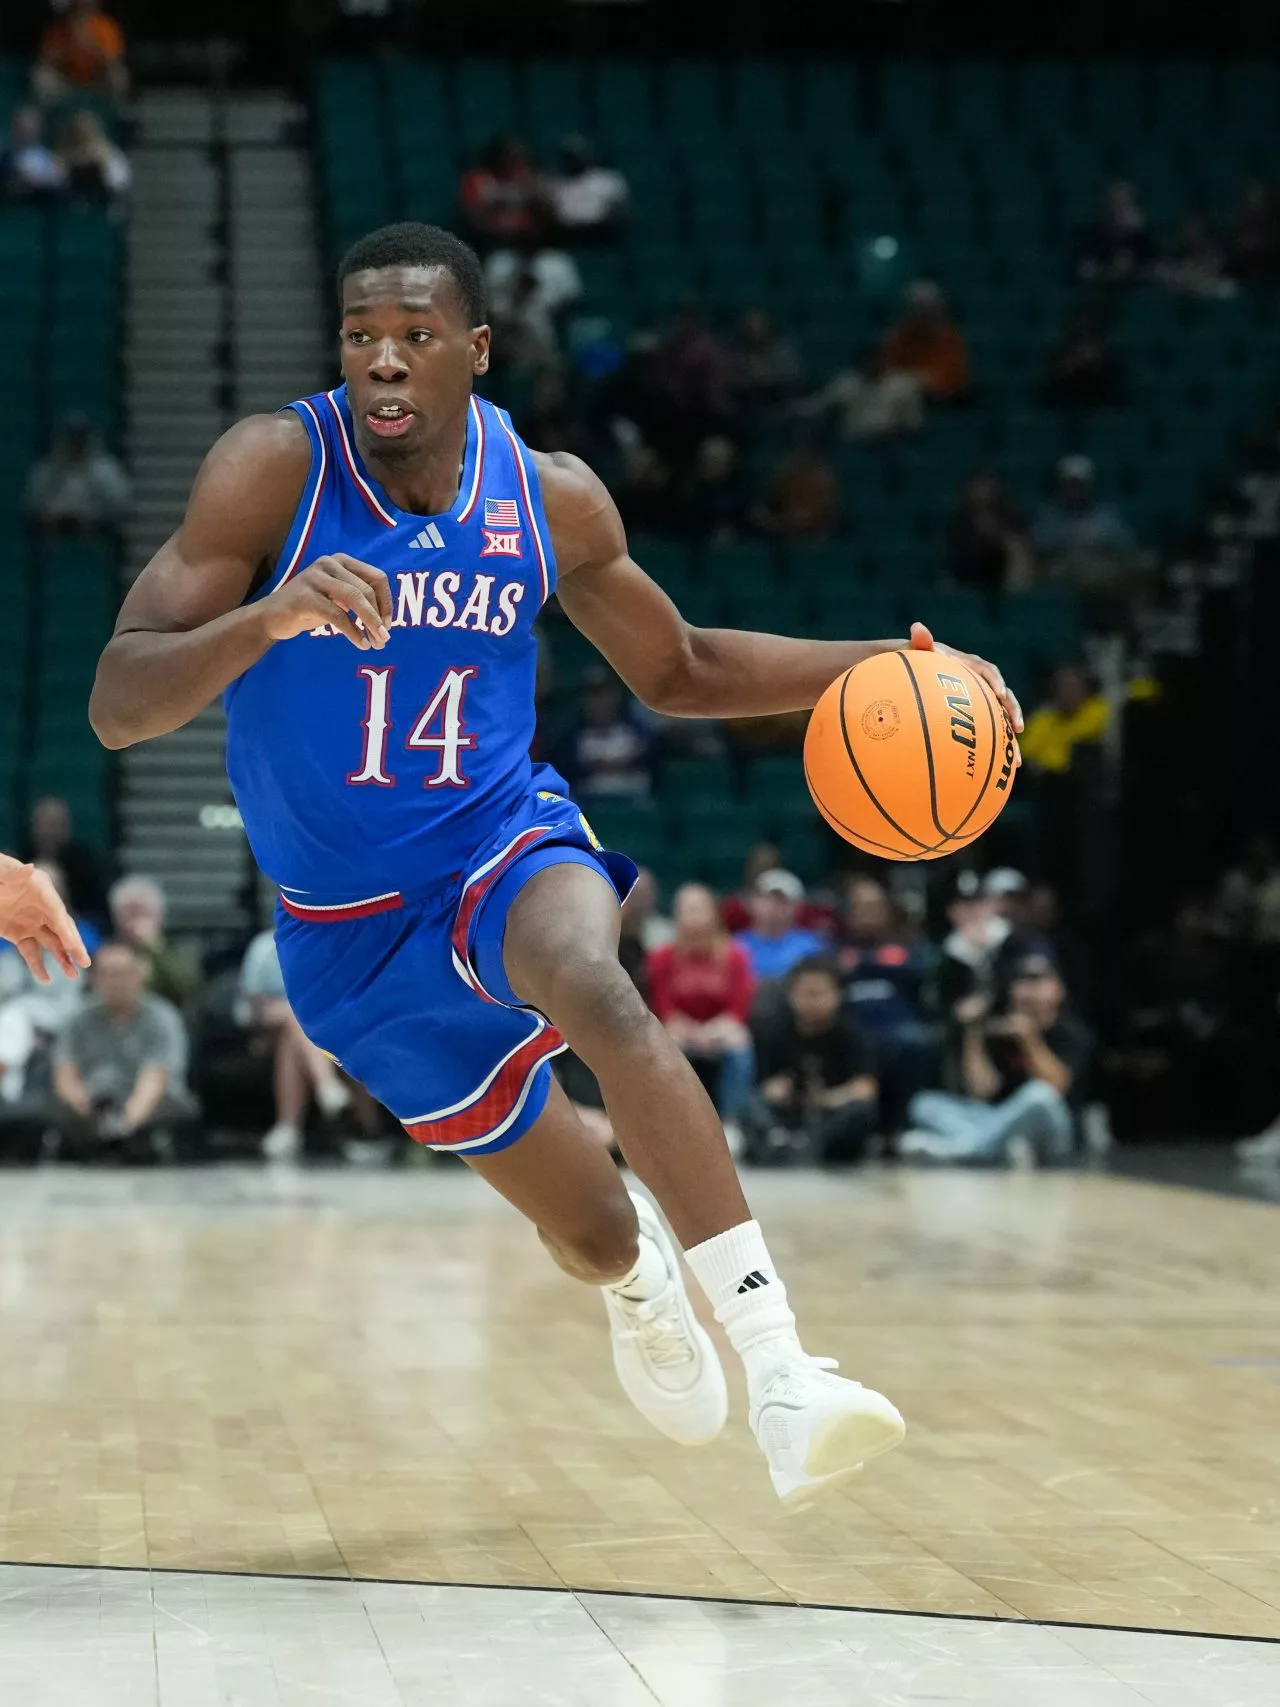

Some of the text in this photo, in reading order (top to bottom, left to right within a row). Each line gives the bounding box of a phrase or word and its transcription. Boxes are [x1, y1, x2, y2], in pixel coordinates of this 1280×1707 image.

[484, 531, 521, 556] XII
[310, 571, 524, 636] NSAS
[346, 665, 479, 789] 14
[936, 672, 977, 780] EVO NXT
